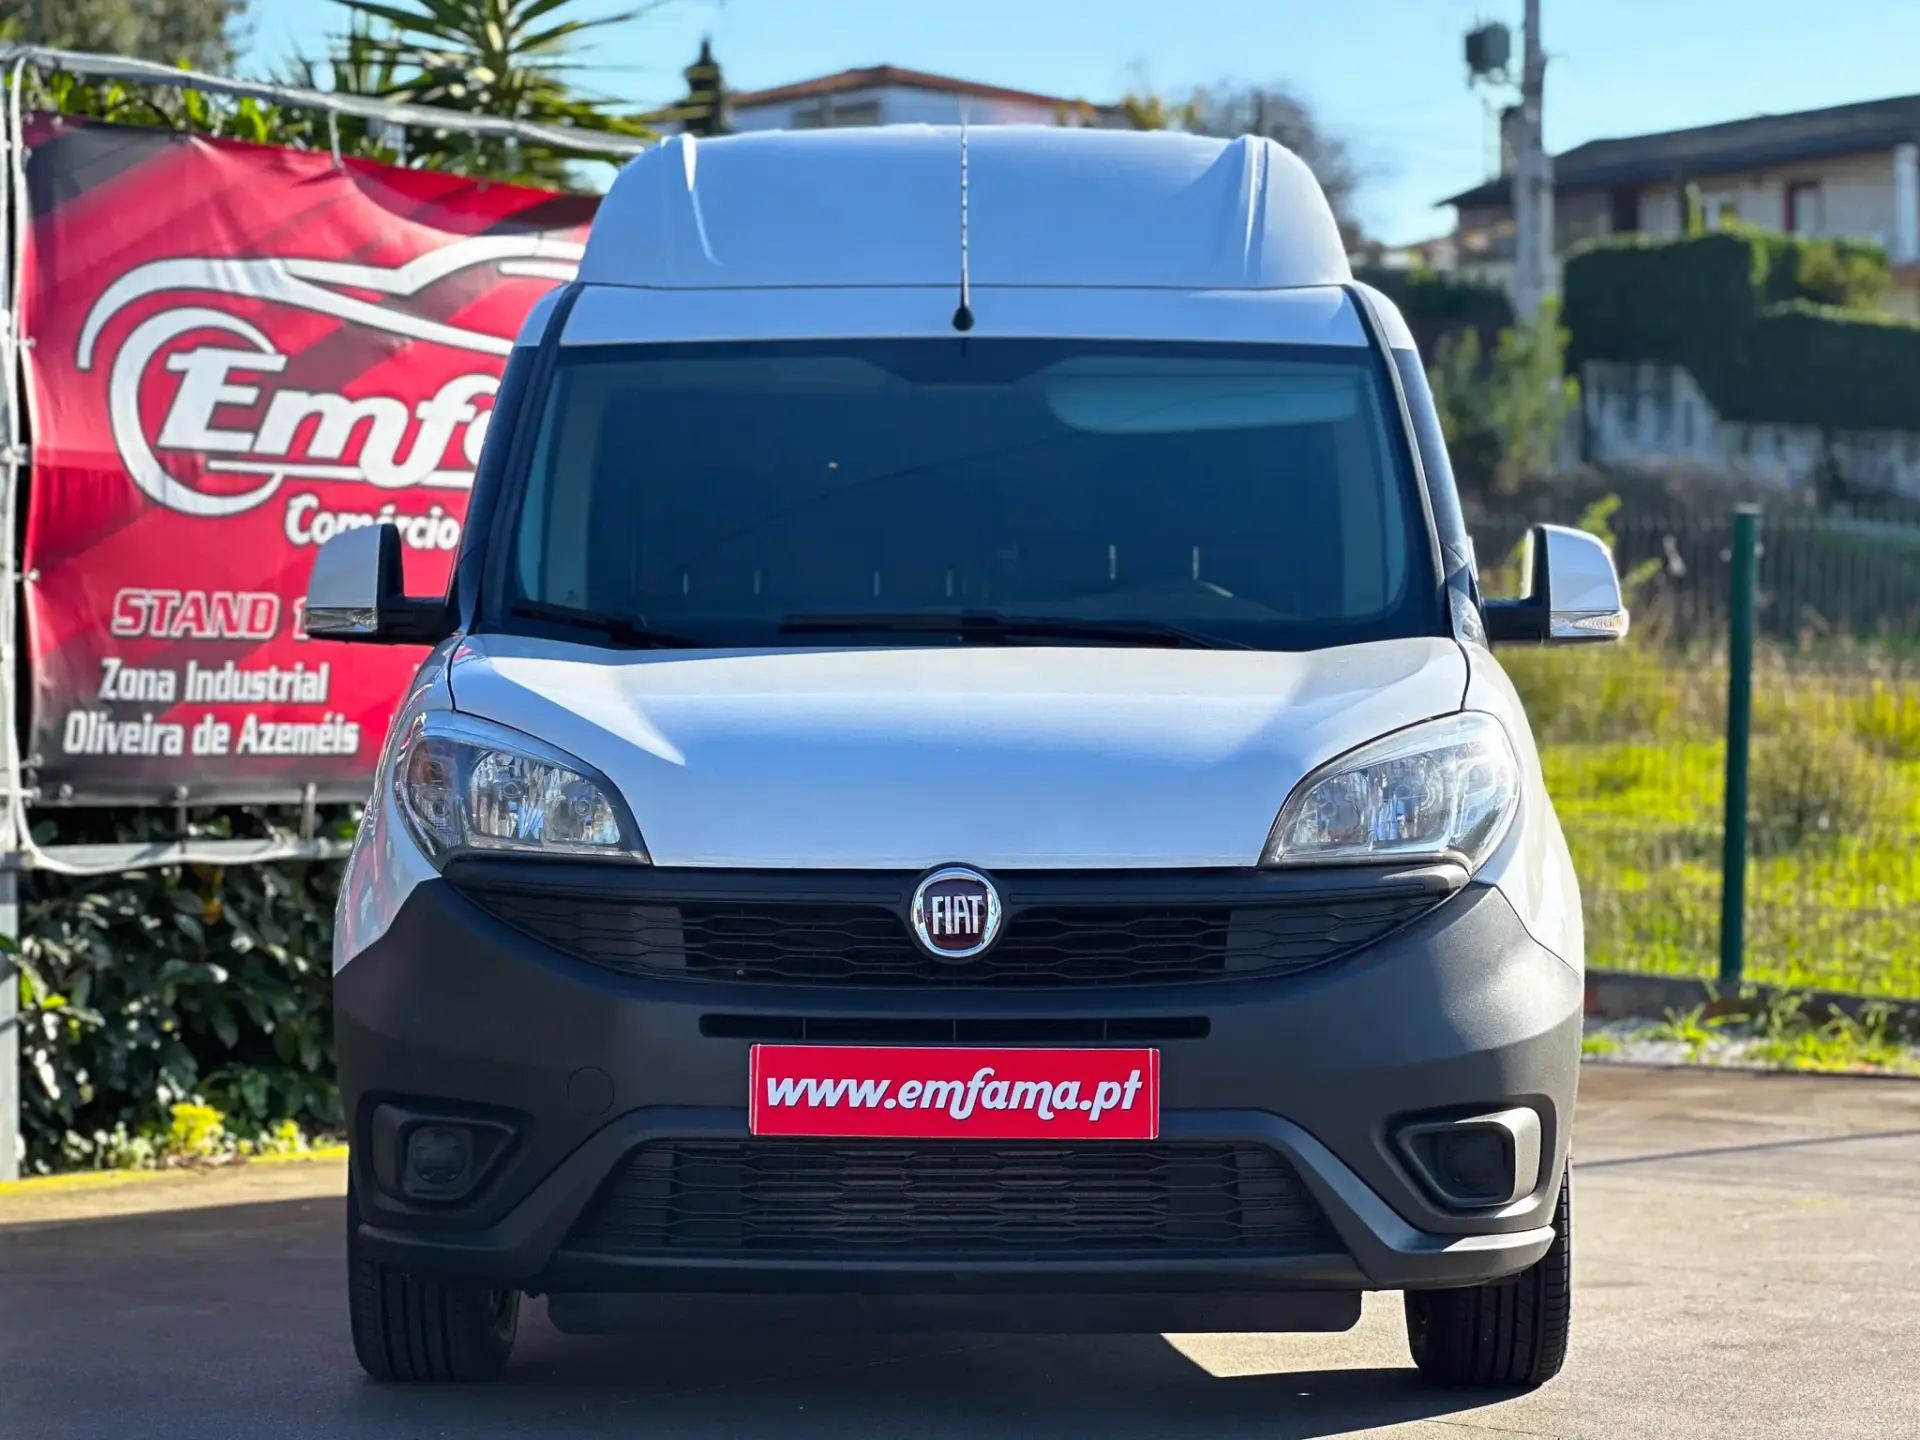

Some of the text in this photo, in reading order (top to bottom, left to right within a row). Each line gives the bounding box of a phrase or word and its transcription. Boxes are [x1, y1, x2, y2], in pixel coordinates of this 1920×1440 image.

[111, 587, 281, 639] STAND
[98, 657, 330, 703] Zona Industrial
[62, 710, 360, 756] Oliveira de Azeméis
[931, 895, 983, 935] FIAT
[766, 1067, 1143, 1122] www.emfama.pt
